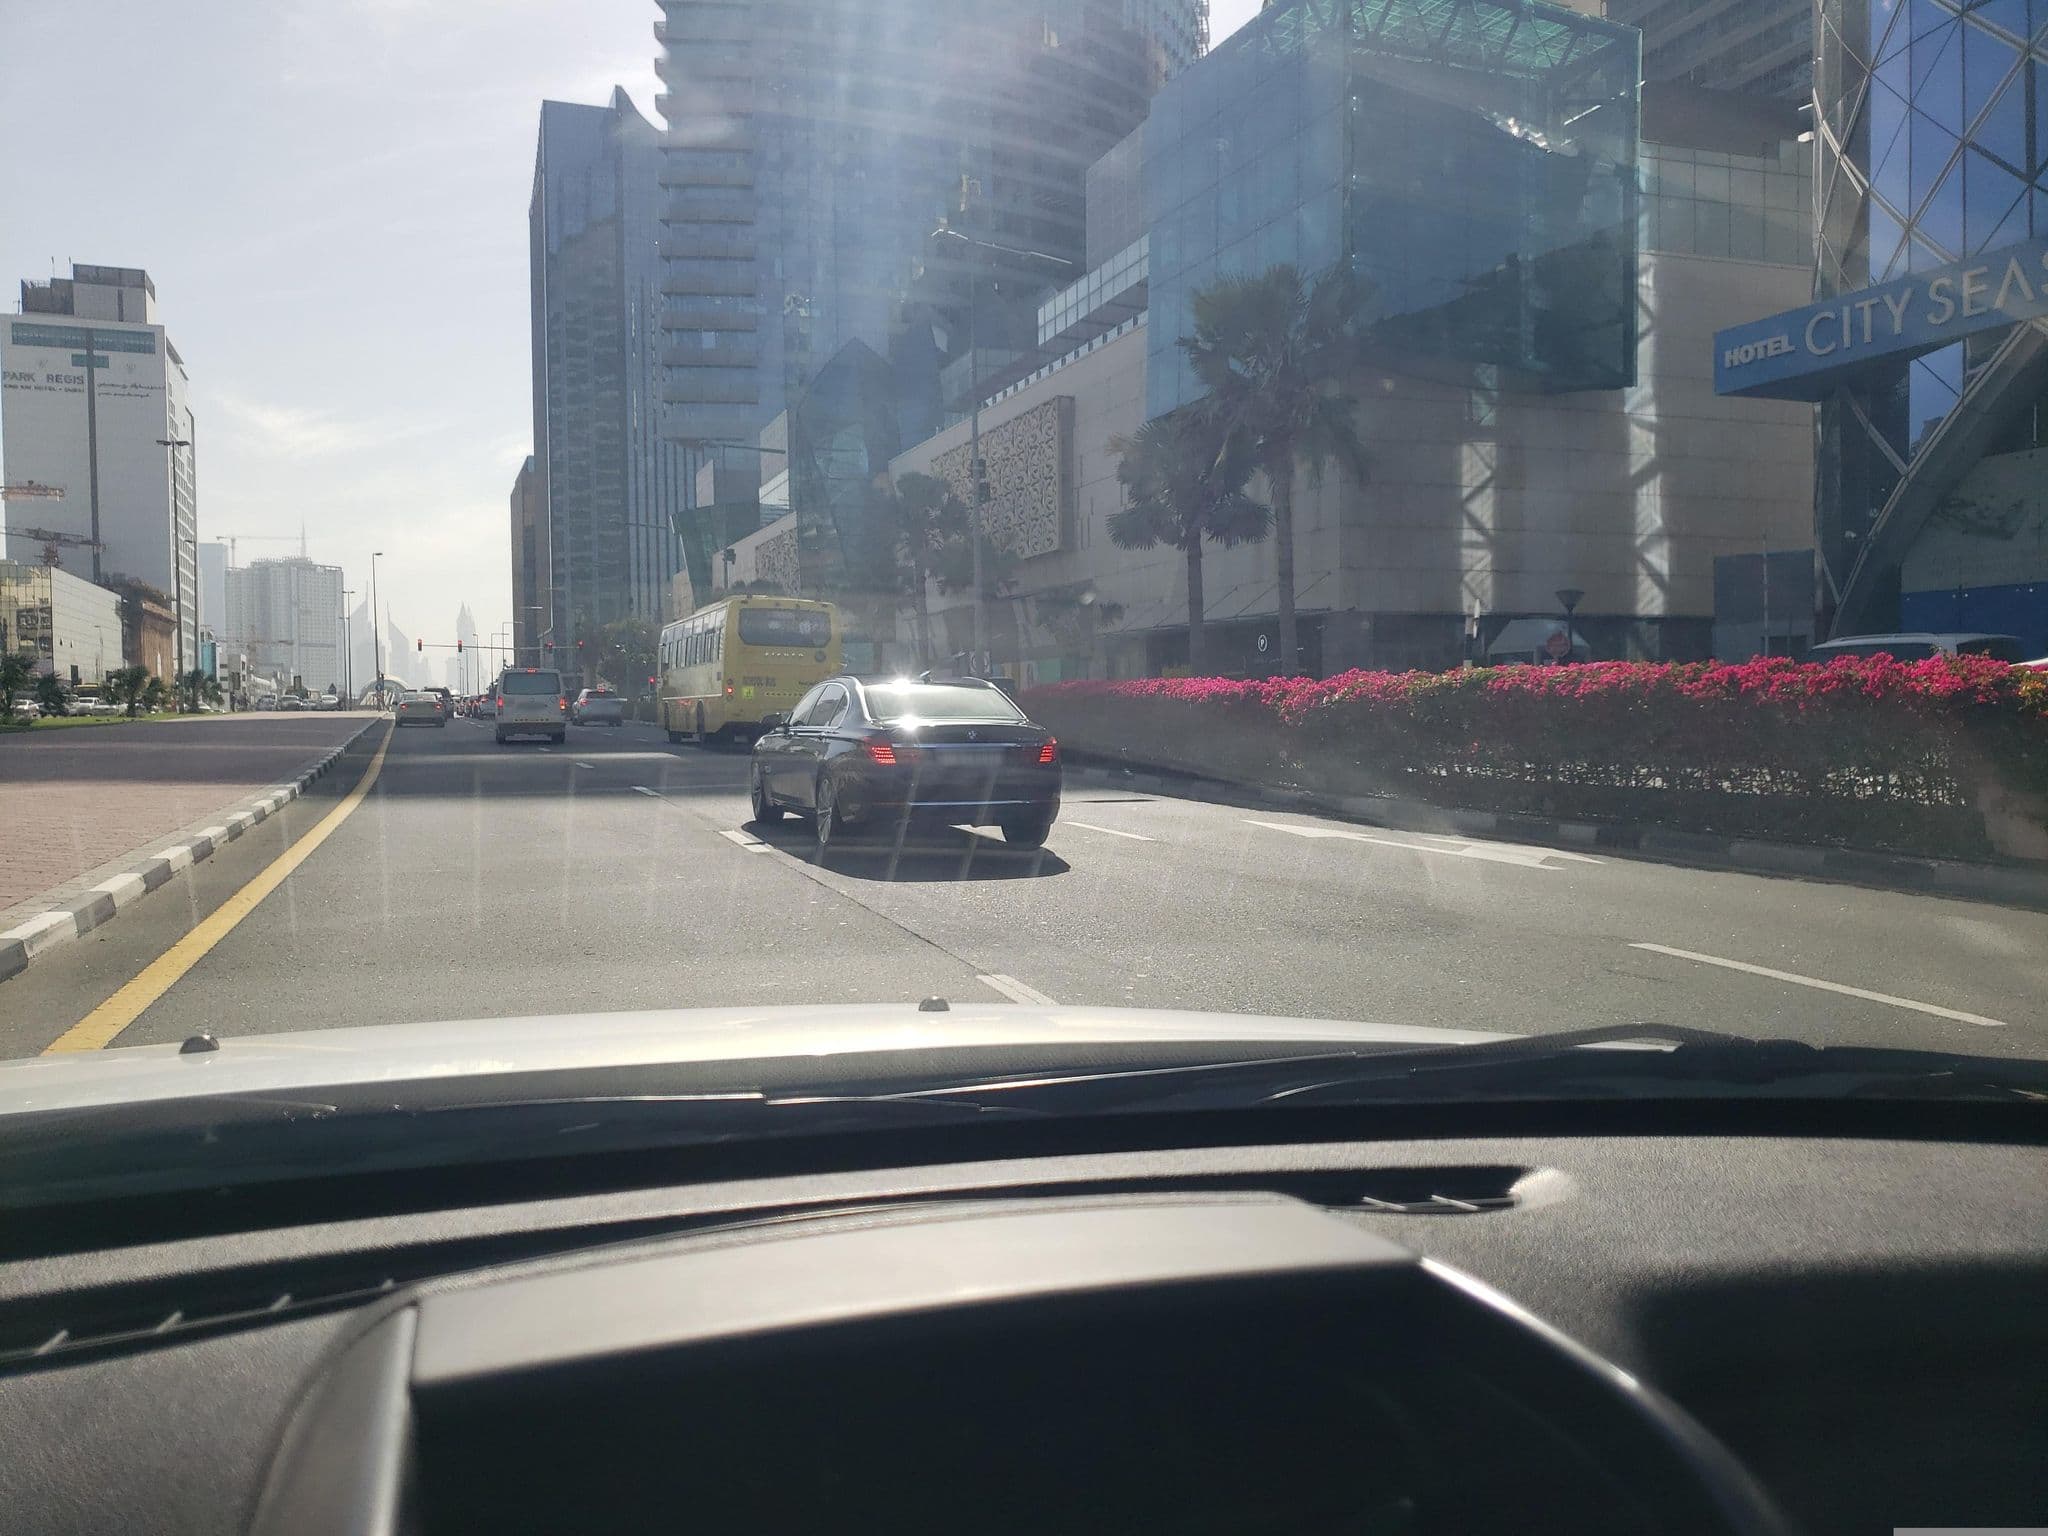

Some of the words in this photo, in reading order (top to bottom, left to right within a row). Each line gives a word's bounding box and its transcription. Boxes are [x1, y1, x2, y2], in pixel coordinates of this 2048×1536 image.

[1725, 335, 1795, 368] HOTEL
[1805, 287, 1912, 355] CITY
[1926, 252, 2048, 325] SEA
[3, 371, 35, 382] PARK
[46, 373, 84, 384] REGIS
